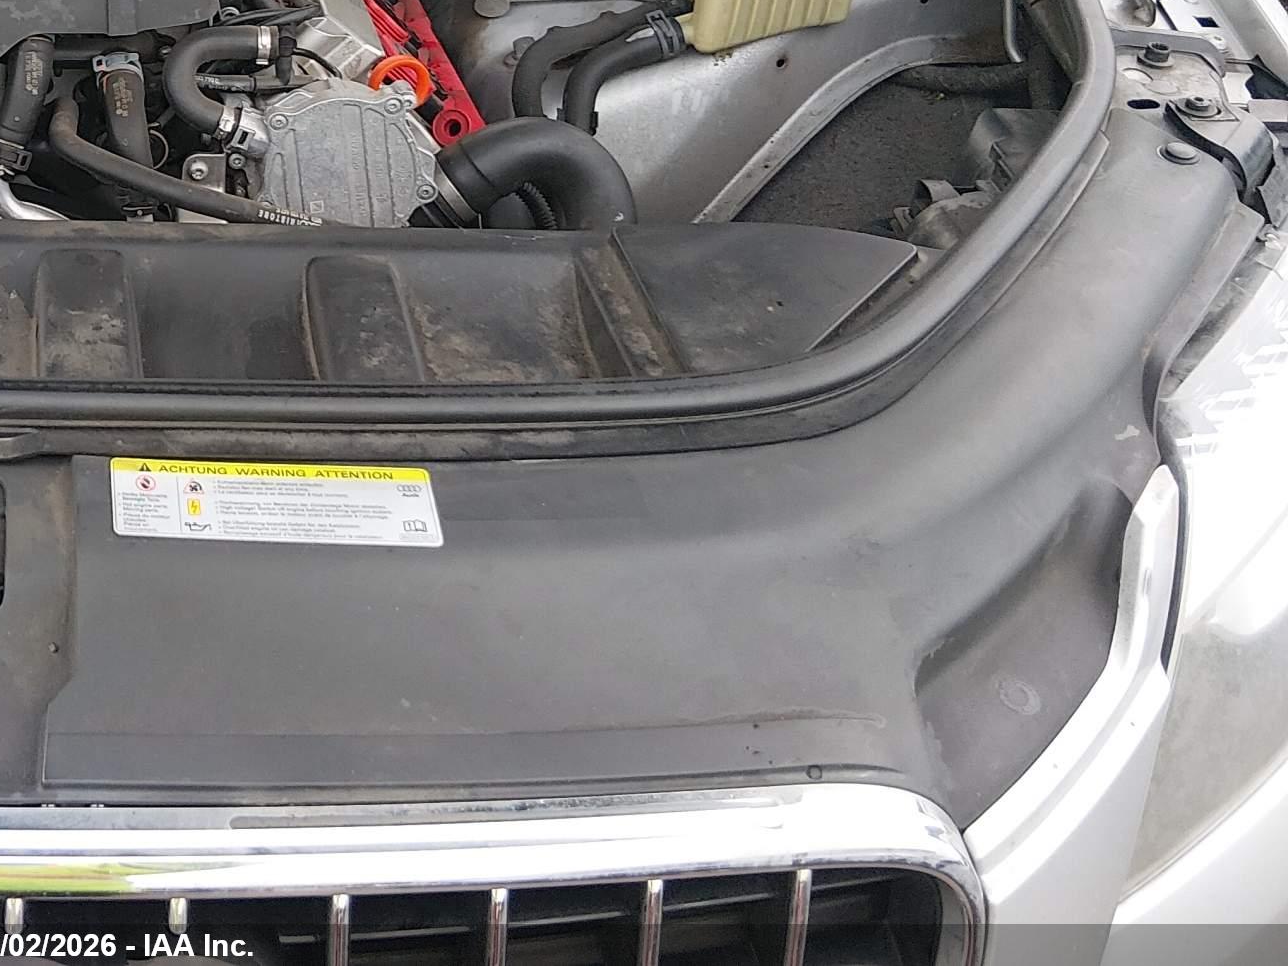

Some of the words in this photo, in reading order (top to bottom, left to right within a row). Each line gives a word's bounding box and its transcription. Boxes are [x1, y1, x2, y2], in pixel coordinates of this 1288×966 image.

[158, 465, 228, 475] ACHTUNG
[235, 467, 307, 478] WARNING
[314, 469, 394, 480] ATTENTION
